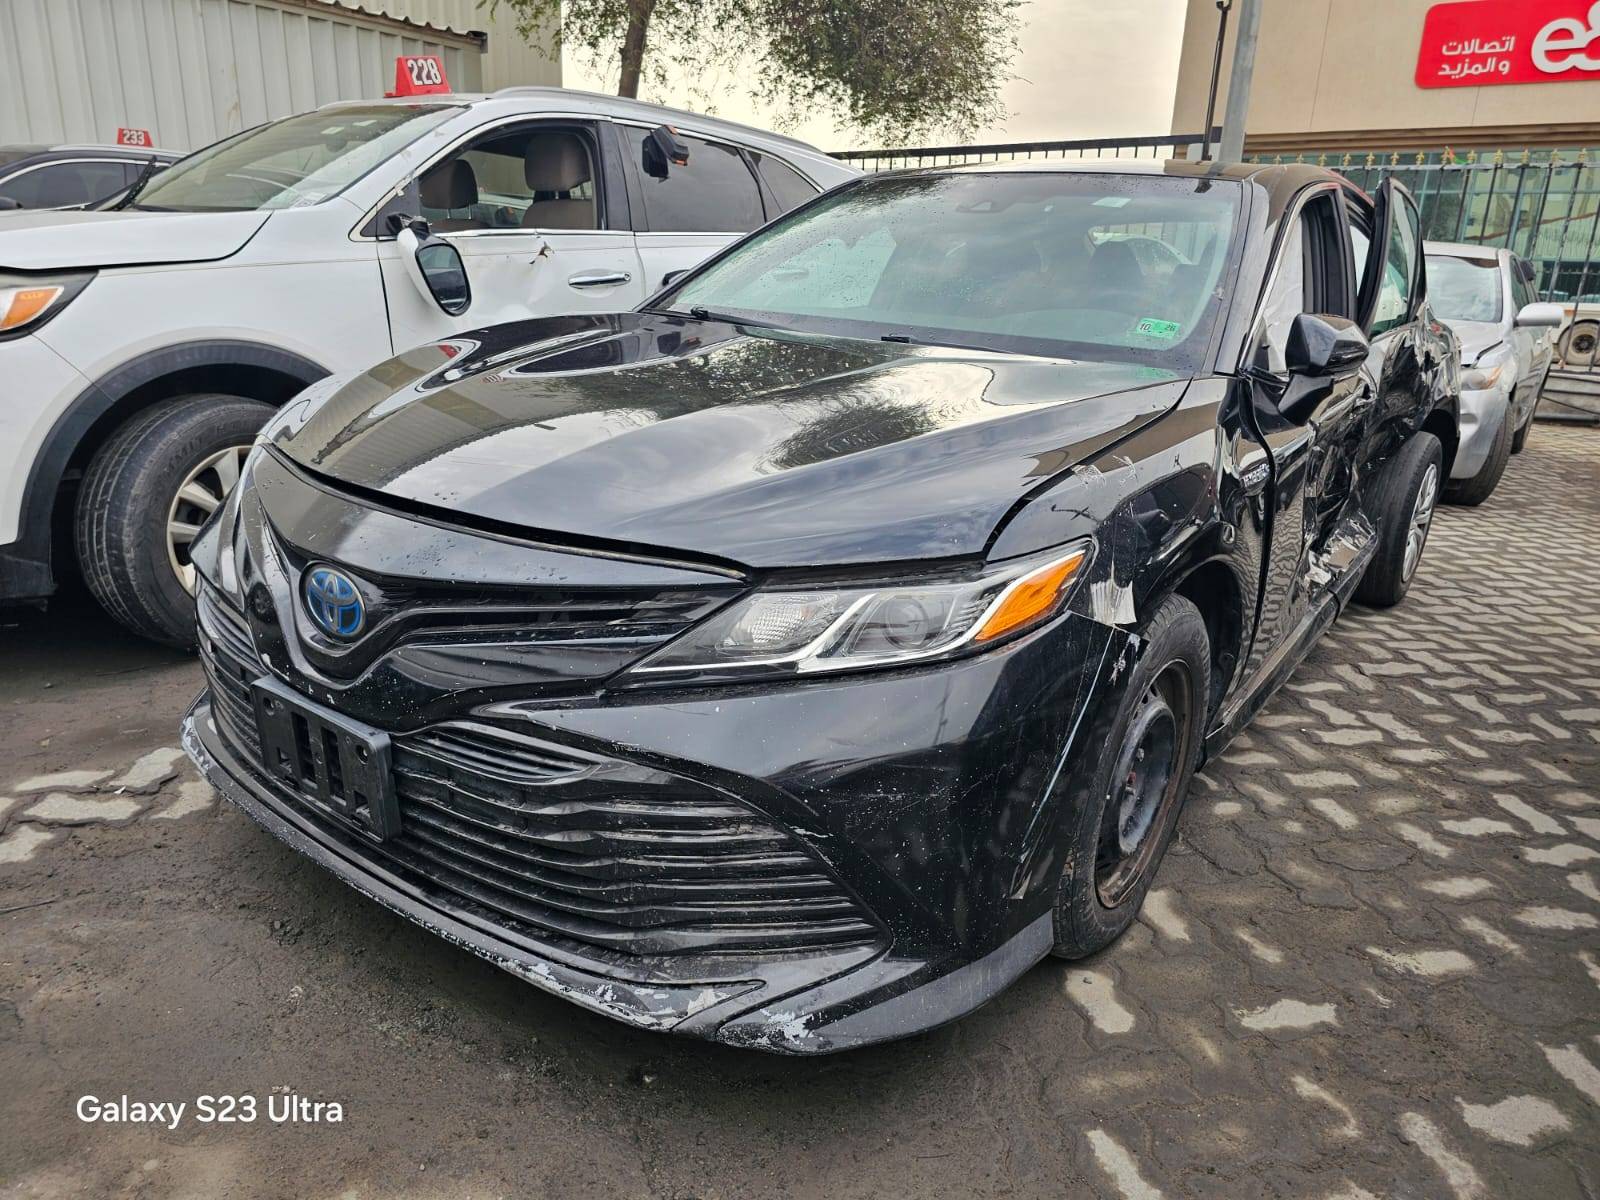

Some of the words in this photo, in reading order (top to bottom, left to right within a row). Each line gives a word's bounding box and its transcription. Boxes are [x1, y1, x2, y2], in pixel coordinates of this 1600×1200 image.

[1441, 36, 1516, 56] اتصالات
[407, 59, 442, 86] 228
[122, 129, 145, 146] 233
